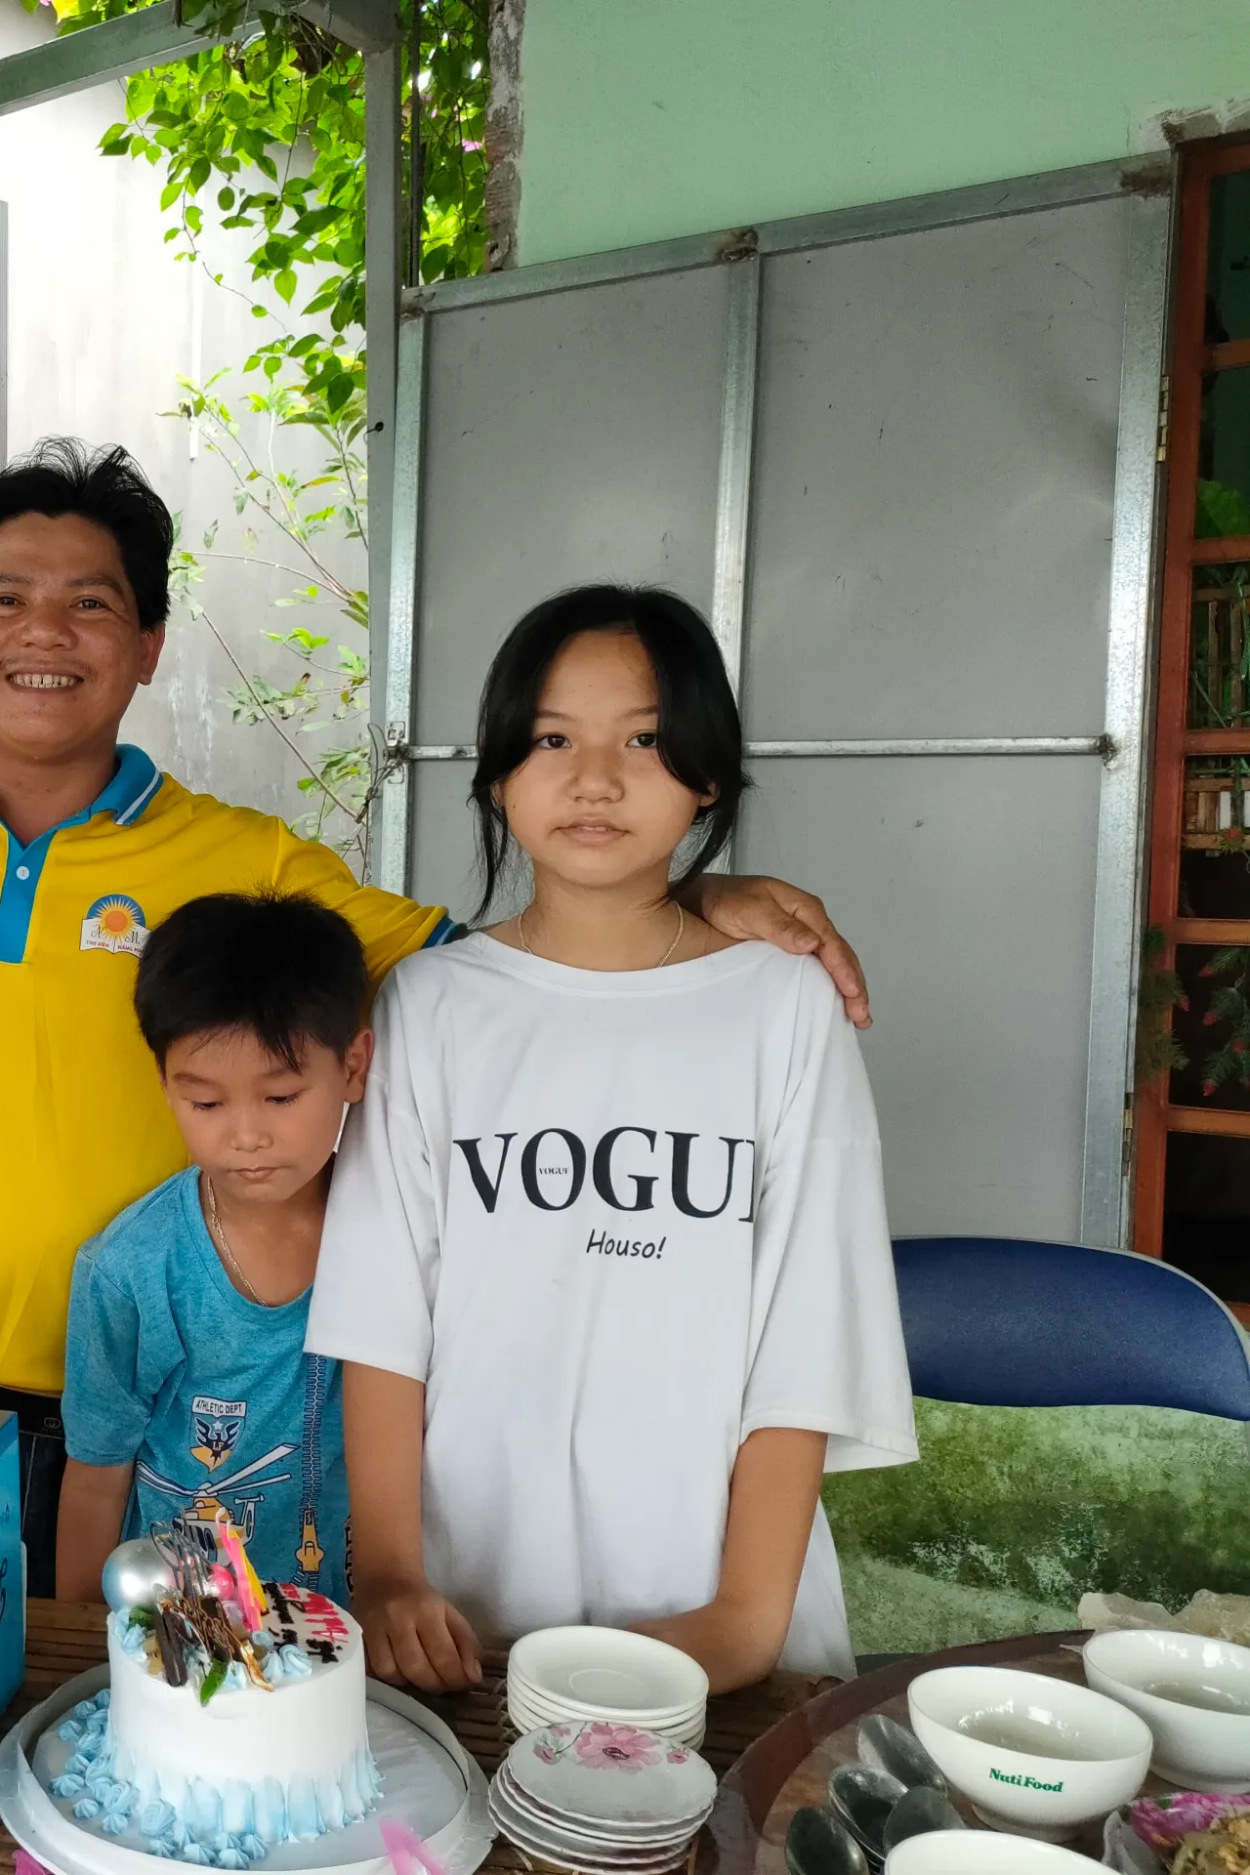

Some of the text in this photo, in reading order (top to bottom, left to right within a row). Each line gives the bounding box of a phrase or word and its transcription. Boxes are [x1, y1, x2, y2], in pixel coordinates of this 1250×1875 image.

[586, 1229, 667, 1259] Houso!
[195, 1399, 243, 1414] ATHLETIC DEPT
